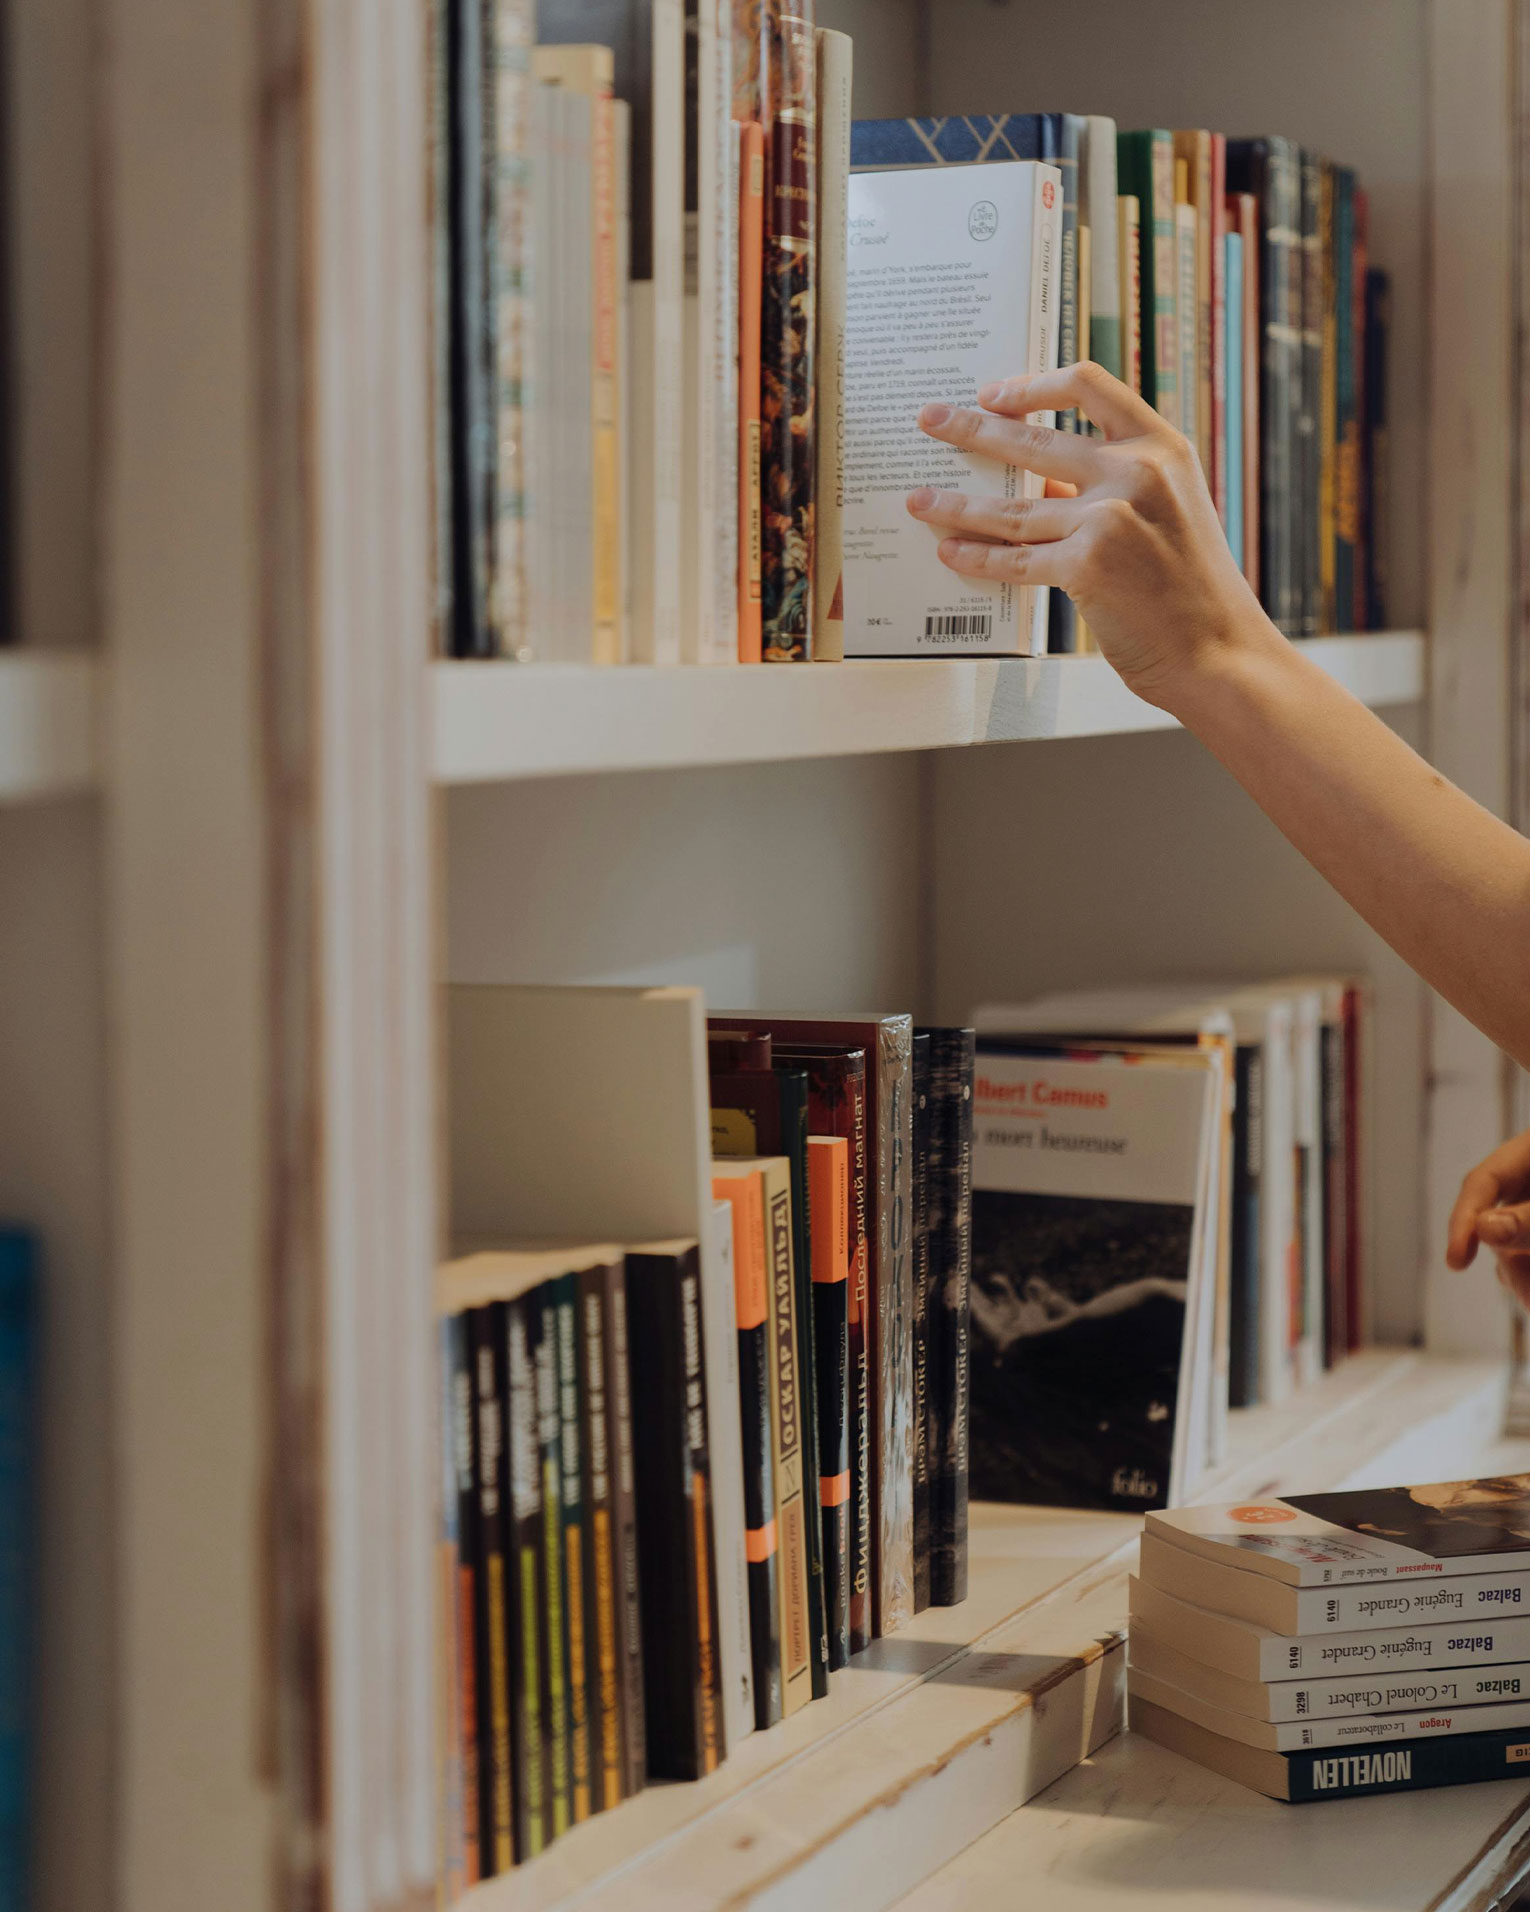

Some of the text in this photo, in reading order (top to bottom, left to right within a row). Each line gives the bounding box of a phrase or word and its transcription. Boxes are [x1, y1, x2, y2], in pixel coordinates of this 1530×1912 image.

[975, 294, 991, 302] Seul
[1041, 277, 1049, 313] DANIEL
[949, 376, 976, 384] succès
[943, 468, 972, 477] histoire
[975, 1077, 1107, 1109] lbert Camus
[852, 1093, 865, 1168] магнат
[1040, 1124, 1128, 1155] heureuse
[852, 1175, 866, 1301] Последний
[772, 1203, 796, 1445] ОСКАР УАЙЛЬД
[916, 1338, 927, 1423] СТОКЕР
[958, 1327, 968, 1412] СТОКЕР
[916, 1424, 927, 1484] БРЭМ
[852, 1349, 870, 1594] Фицджеральд
[1112, 1464, 1158, 1499] folio
[1356, 1567, 1366, 1578] de
[1367, 1567, 1388, 1577] Boule
[1396, 1562, 1443, 1574] Maupassant
[1326, 1587, 1521, 1623] Balzac Eugénie Grandet 6140
[1289, 1636, 1493, 1669] Balzac Eugénie Grandet 6140
[1295, 1678, 1521, 1714] Balzac Le Colonel Chabert 3298
[1336, 1722, 1394, 1737] collaborateur
[1393, 1722, 1405, 1733] Le
[1419, 1717, 1452, 1730] Aragon
[1312, 1750, 1412, 1790] NOVELLEN
